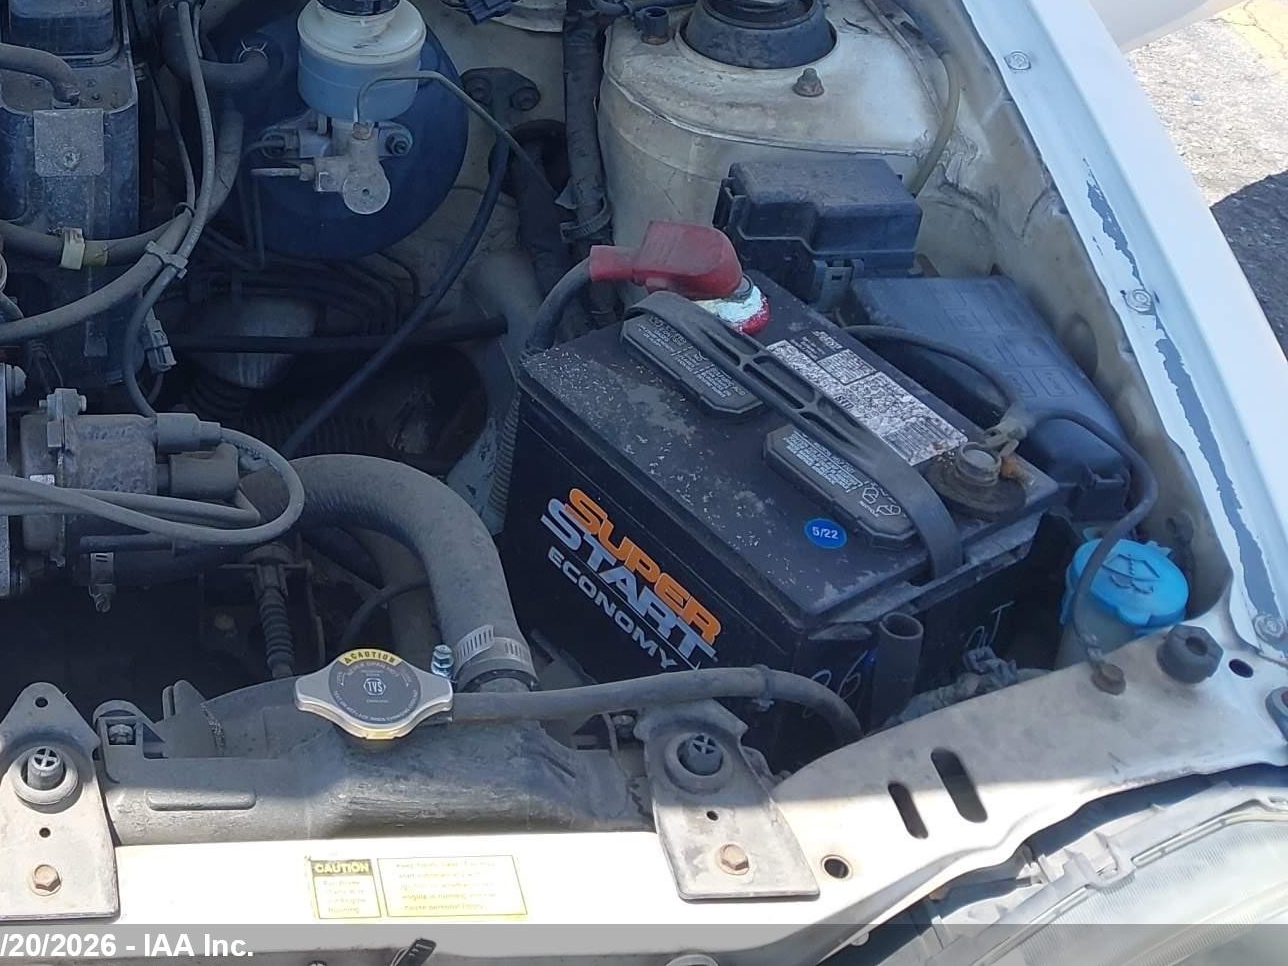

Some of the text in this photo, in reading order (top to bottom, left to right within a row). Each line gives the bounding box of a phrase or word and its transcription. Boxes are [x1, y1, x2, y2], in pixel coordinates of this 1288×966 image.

[812, 526, 840, 540] 5/22
[564, 488, 722, 645] SUPER
[540, 498, 717, 659] START
[548, 546, 679, 669] ECONOMY
[350, 651, 396, 664] CAUTION
[366, 681, 383, 693] TVS
[314, 862, 370, 874] CAUTION
